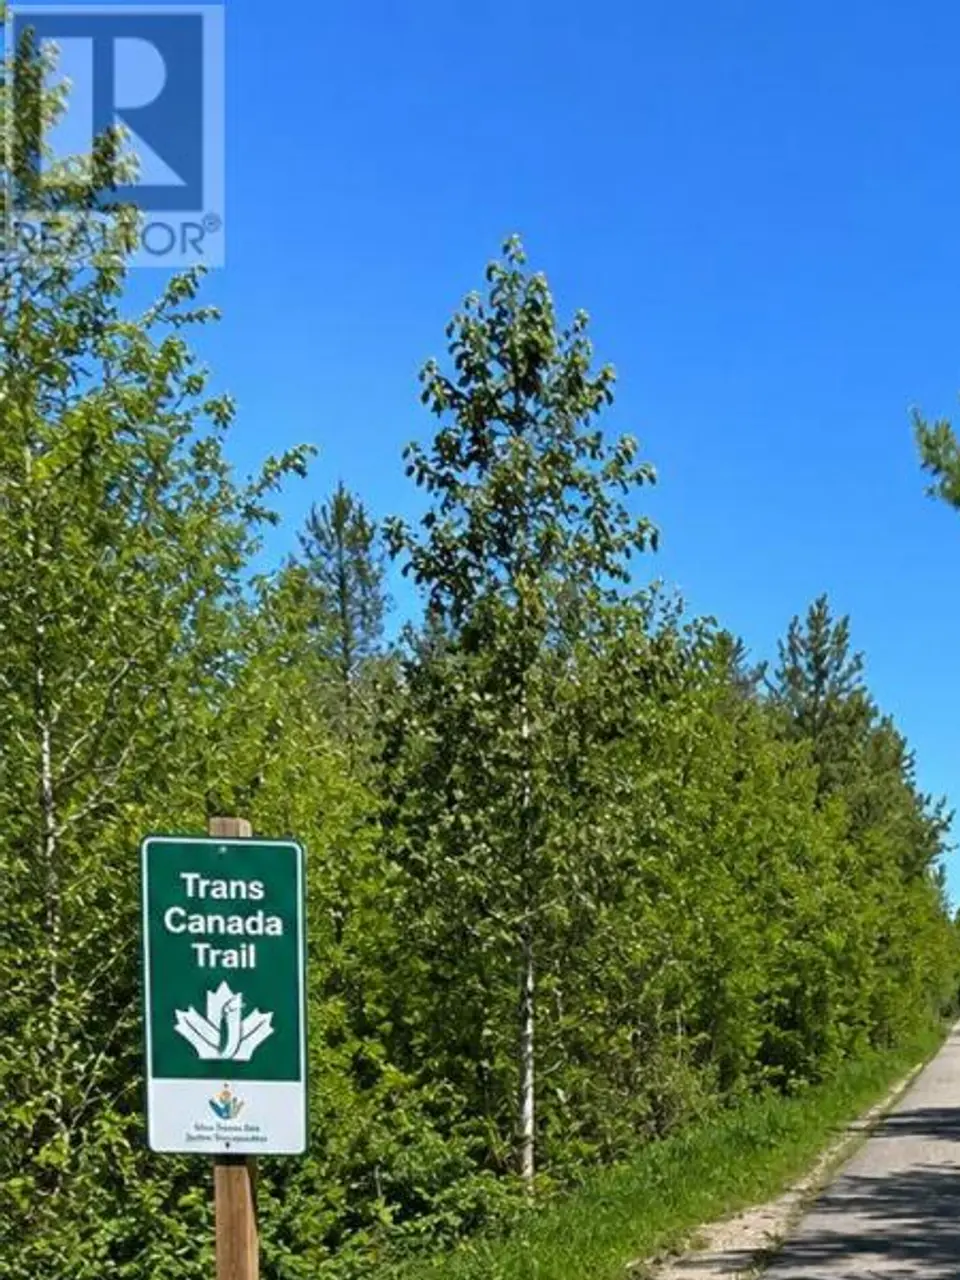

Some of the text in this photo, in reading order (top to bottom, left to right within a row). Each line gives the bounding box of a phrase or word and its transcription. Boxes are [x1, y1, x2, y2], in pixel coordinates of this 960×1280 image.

[180, 873, 265, 900] Trans
[164, 906, 283, 936] Canada
[191, 943, 256, 969] Trail
